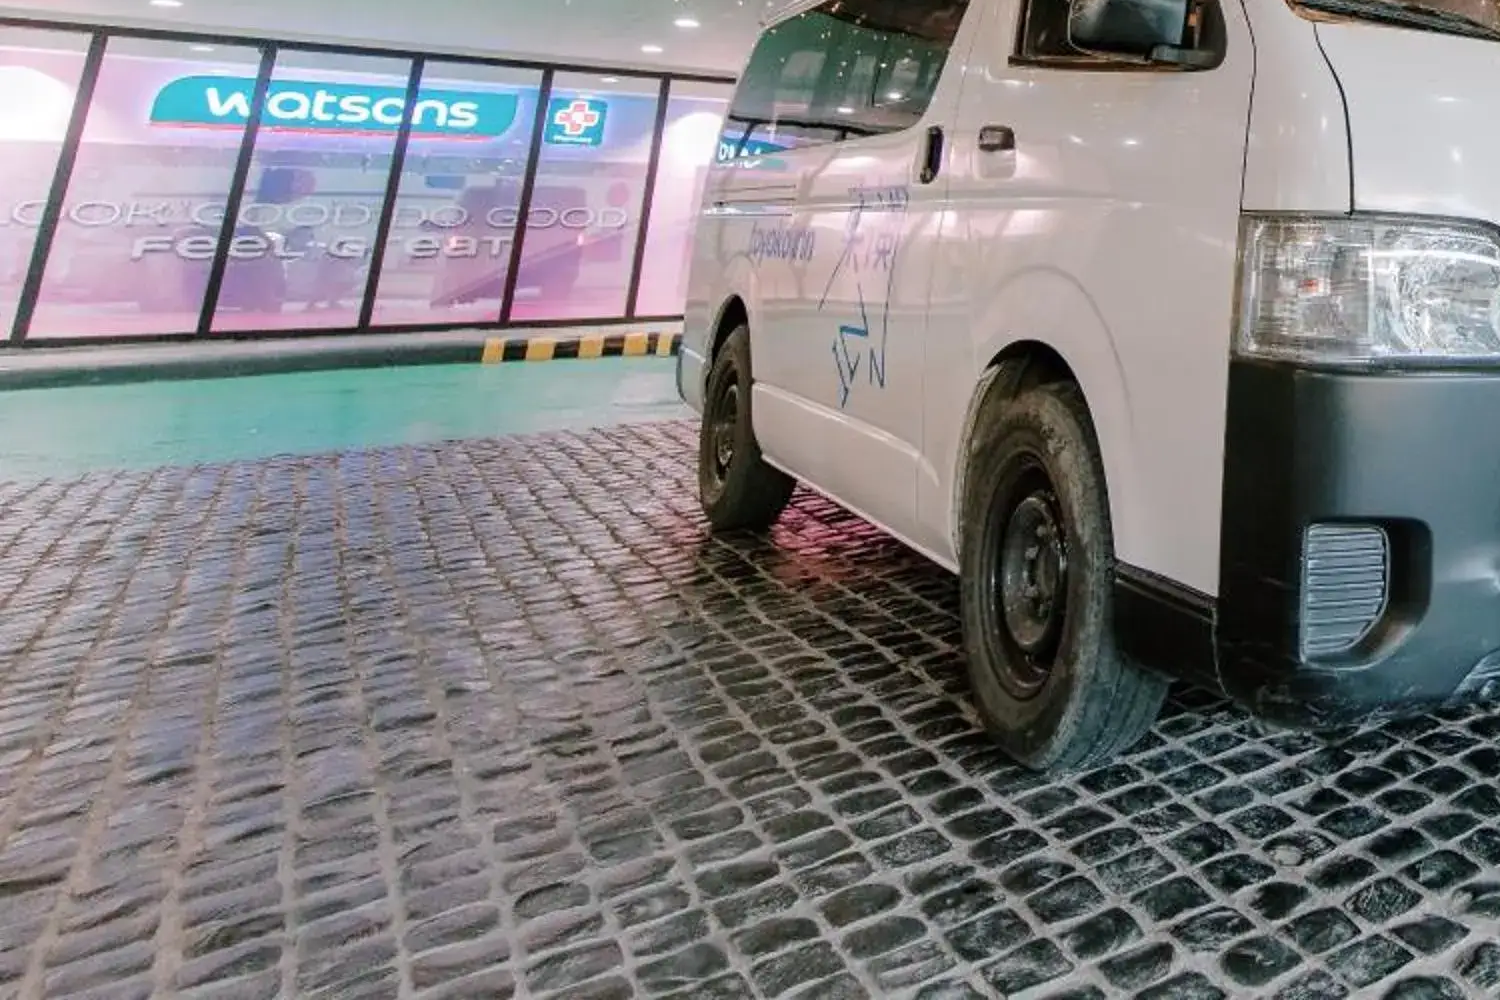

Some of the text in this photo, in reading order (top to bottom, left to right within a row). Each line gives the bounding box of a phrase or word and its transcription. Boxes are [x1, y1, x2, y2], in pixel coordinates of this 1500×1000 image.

[206, 86, 479, 128] watsons
[0, 198, 168, 228] OOK
[192, 201, 372, 230] GOOD
[486, 206, 628, 230] GOOD
